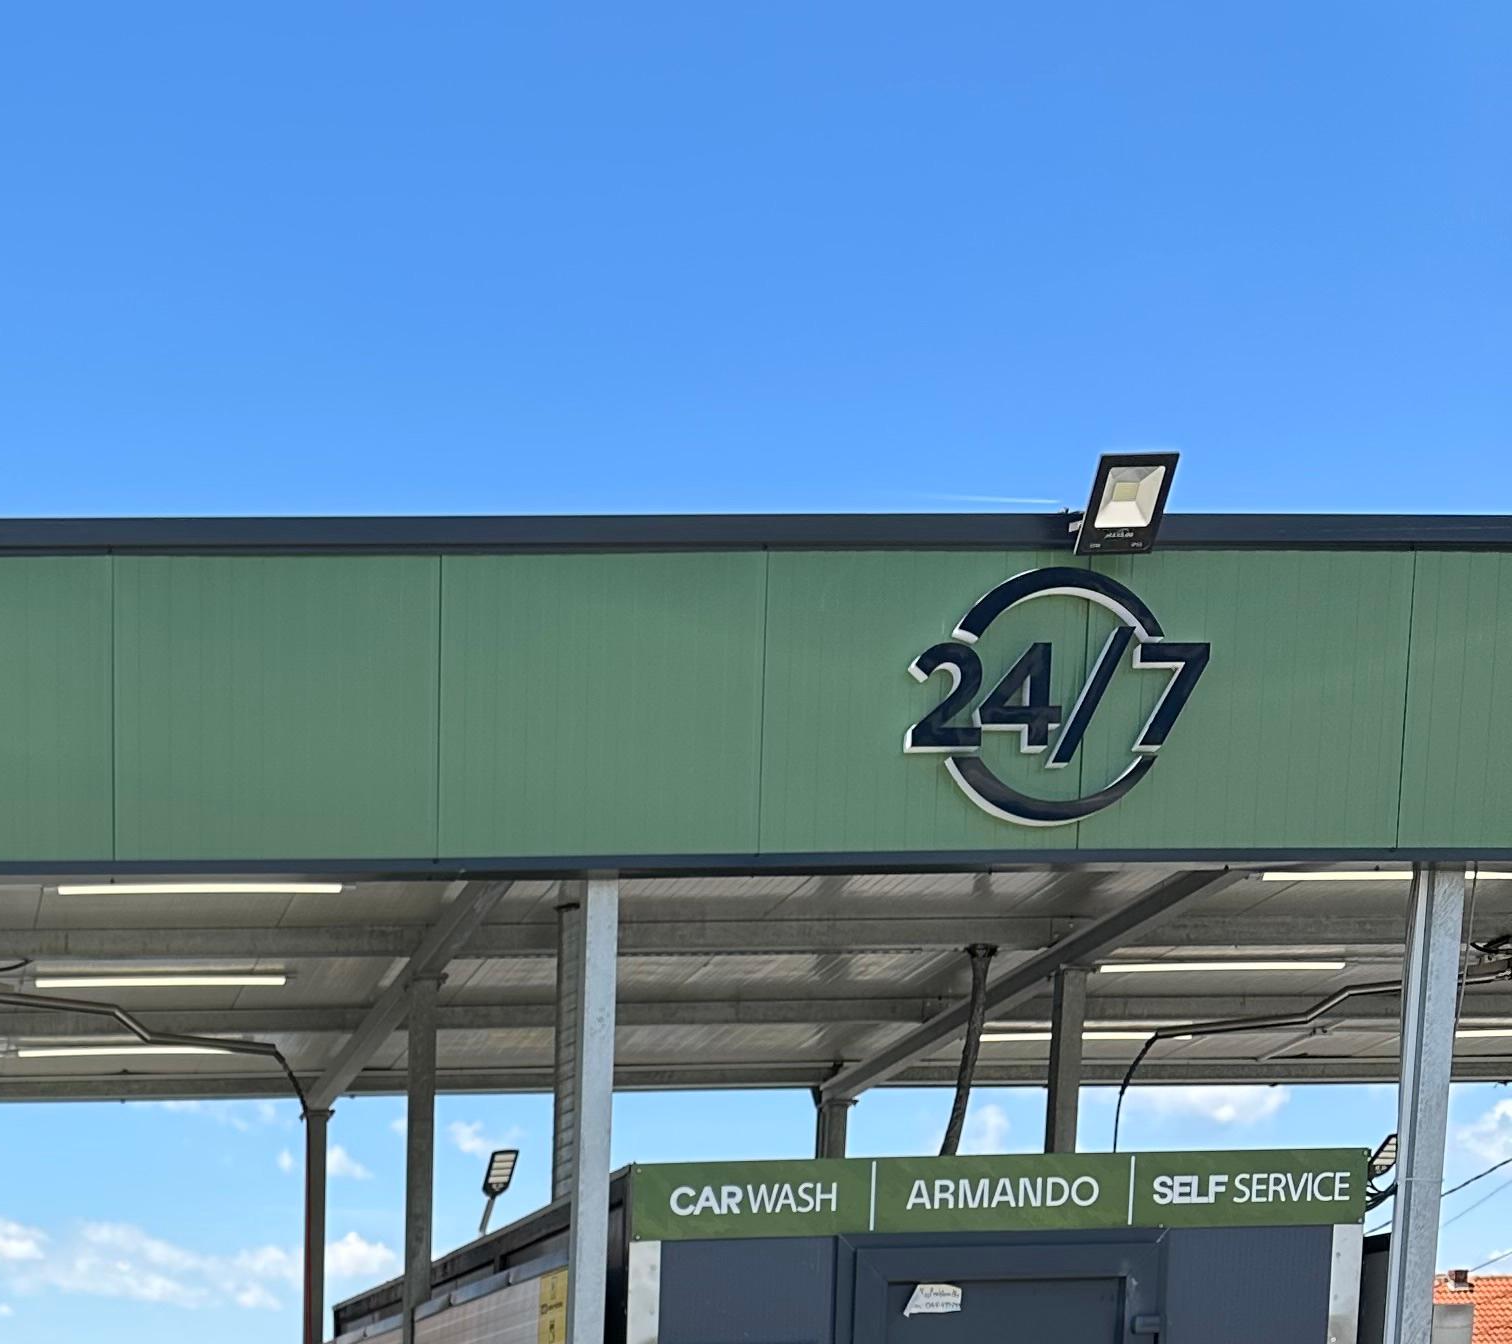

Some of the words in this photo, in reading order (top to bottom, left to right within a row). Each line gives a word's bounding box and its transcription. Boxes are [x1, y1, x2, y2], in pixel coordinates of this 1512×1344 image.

[903, 625, 1211, 769] 24/7
[670, 1185, 743, 1216] CAR
[746, 1181, 837, 1213] WASH
[906, 1176, 1100, 1210] ARMANDO
[1152, 1174, 1229, 1205] SELF
[1232, 1171, 1351, 1203] SERVICE
